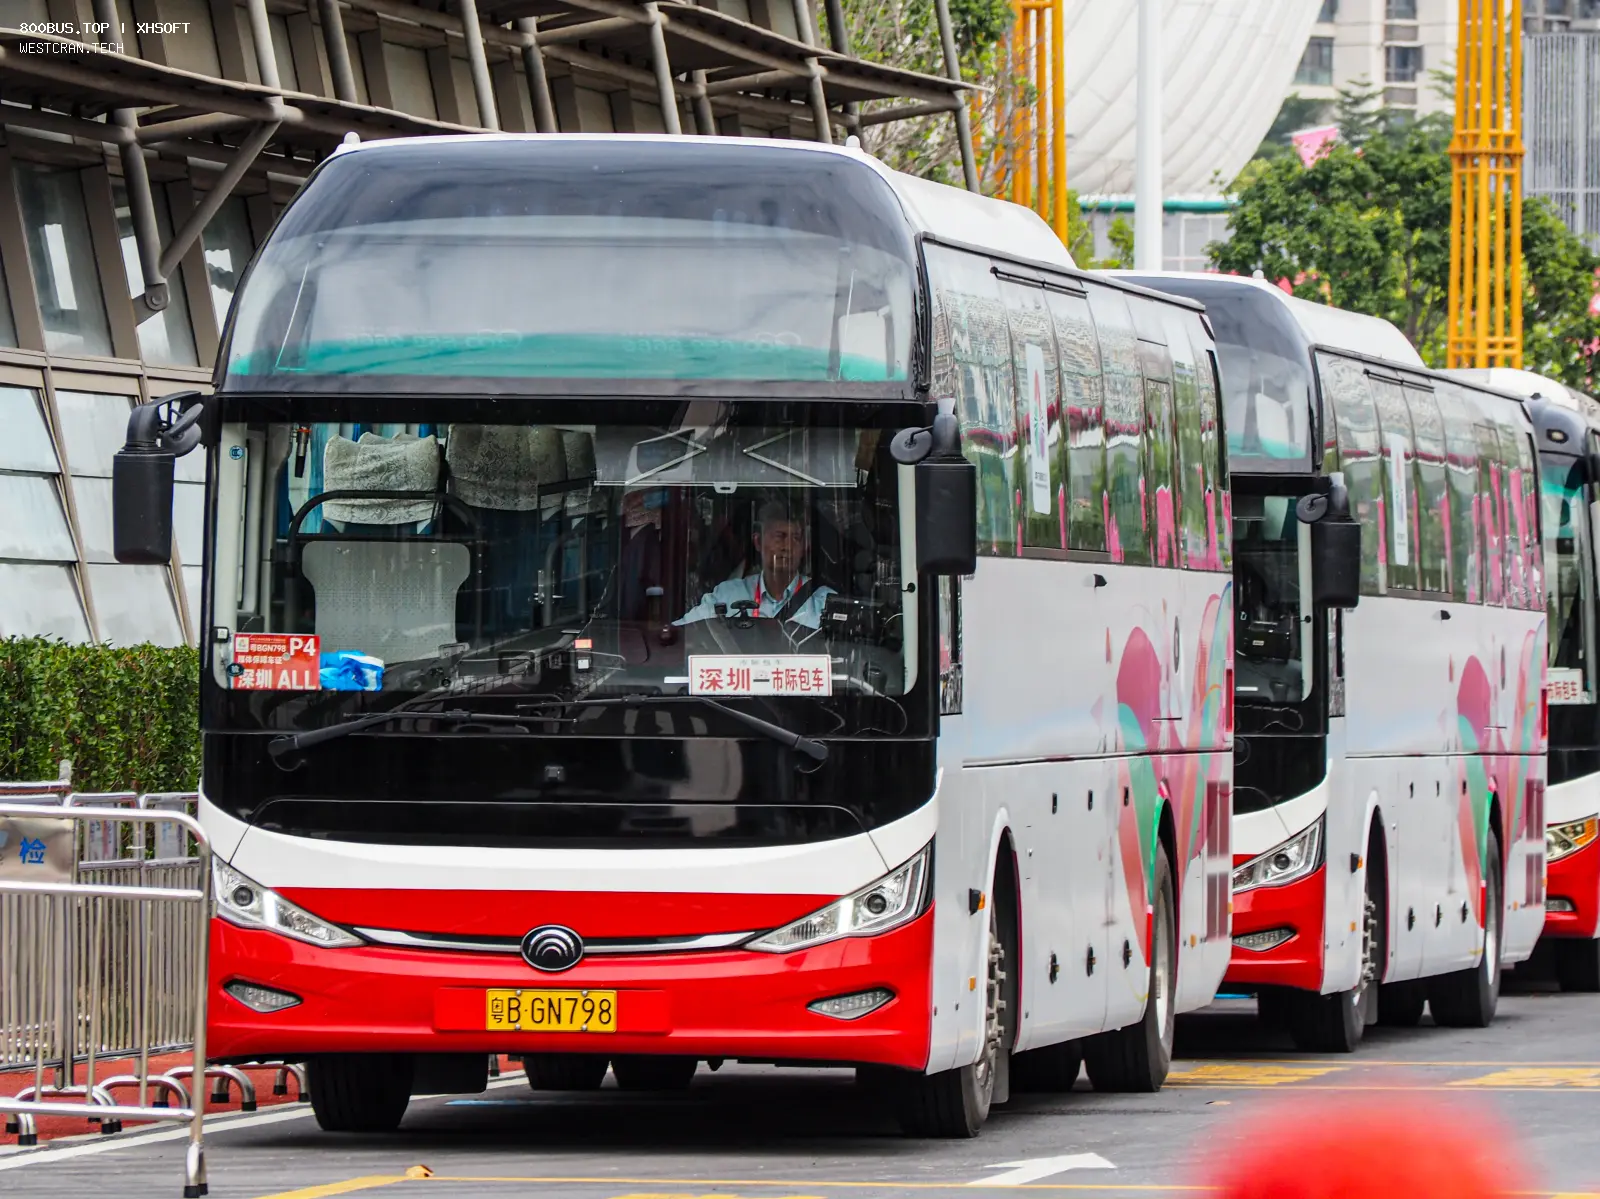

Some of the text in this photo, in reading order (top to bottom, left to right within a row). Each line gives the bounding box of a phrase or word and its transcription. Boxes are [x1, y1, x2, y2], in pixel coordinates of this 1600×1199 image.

[289, 637, 316, 656] P4
[277, 670, 316, 689] ALL
[19, 836, 47, 864] 检
